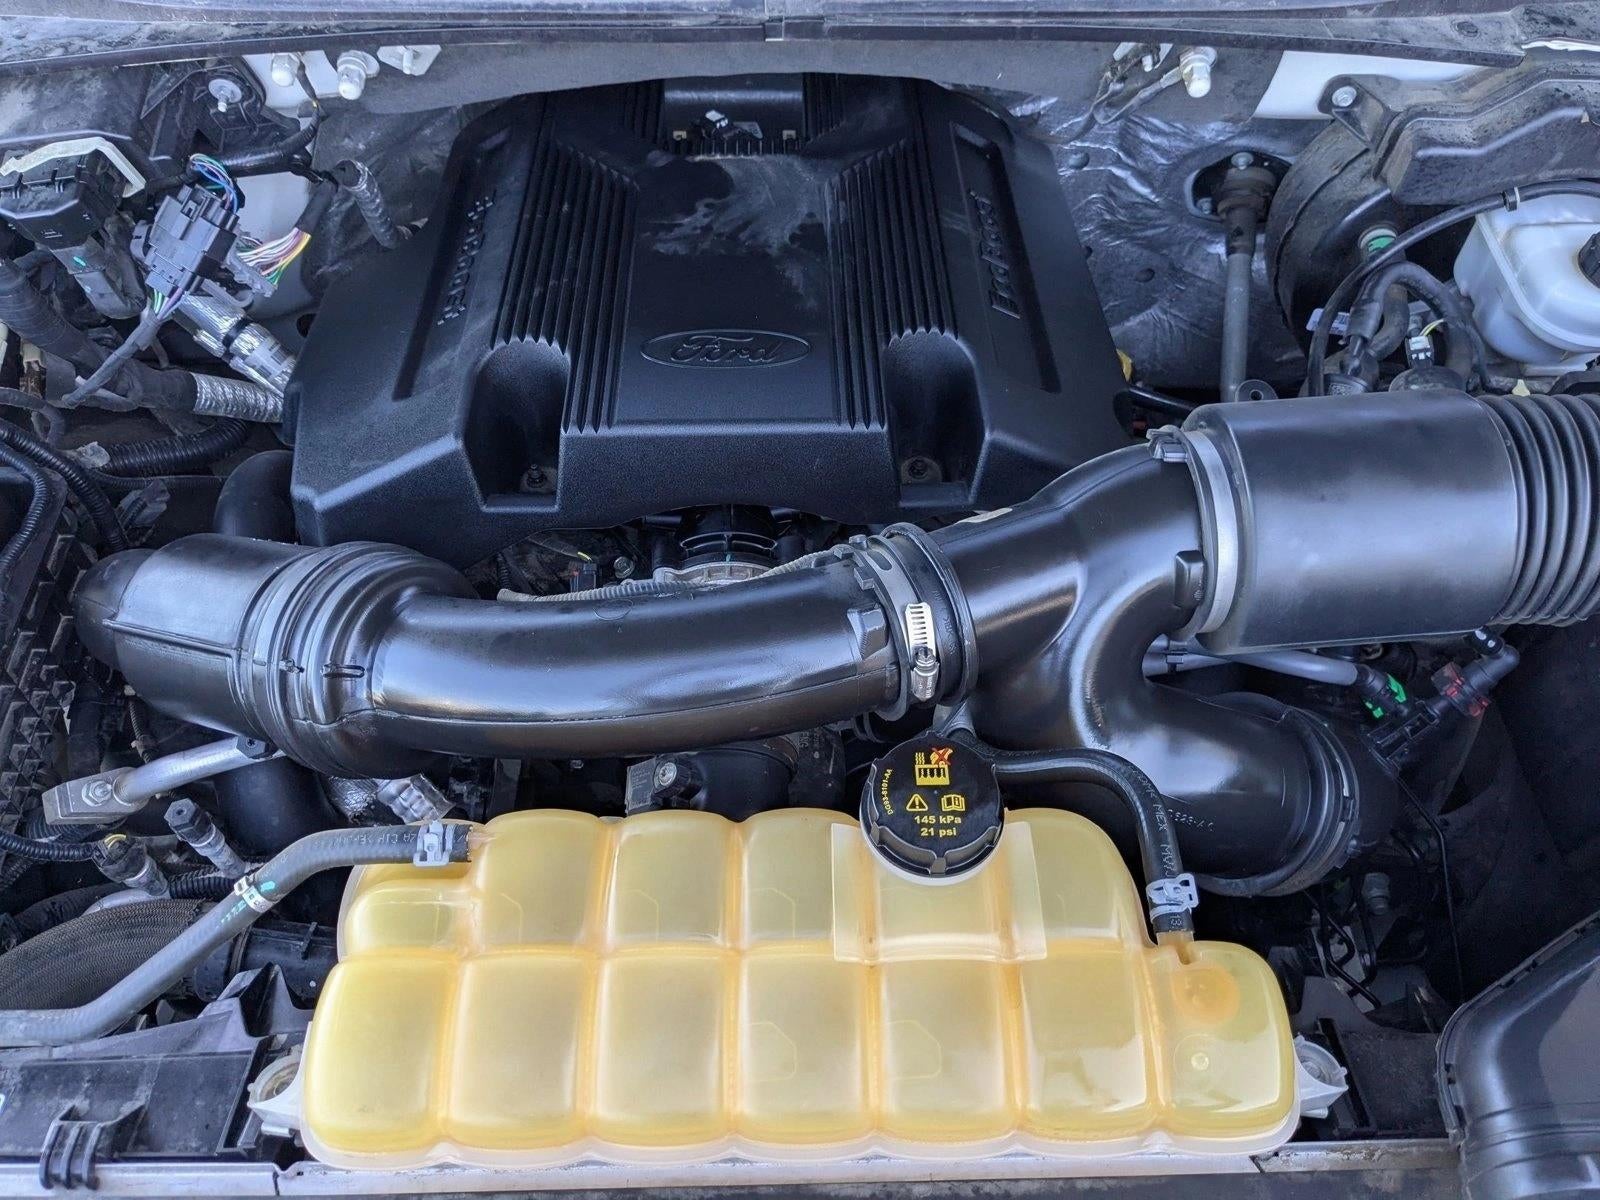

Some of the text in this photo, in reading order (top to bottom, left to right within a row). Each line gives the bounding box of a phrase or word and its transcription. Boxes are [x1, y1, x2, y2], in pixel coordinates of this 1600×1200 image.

[669, 334, 784, 363] Ford
[914, 815, 962, 824] 145 kPa
[920, 827, 957, 838] 21 psi
